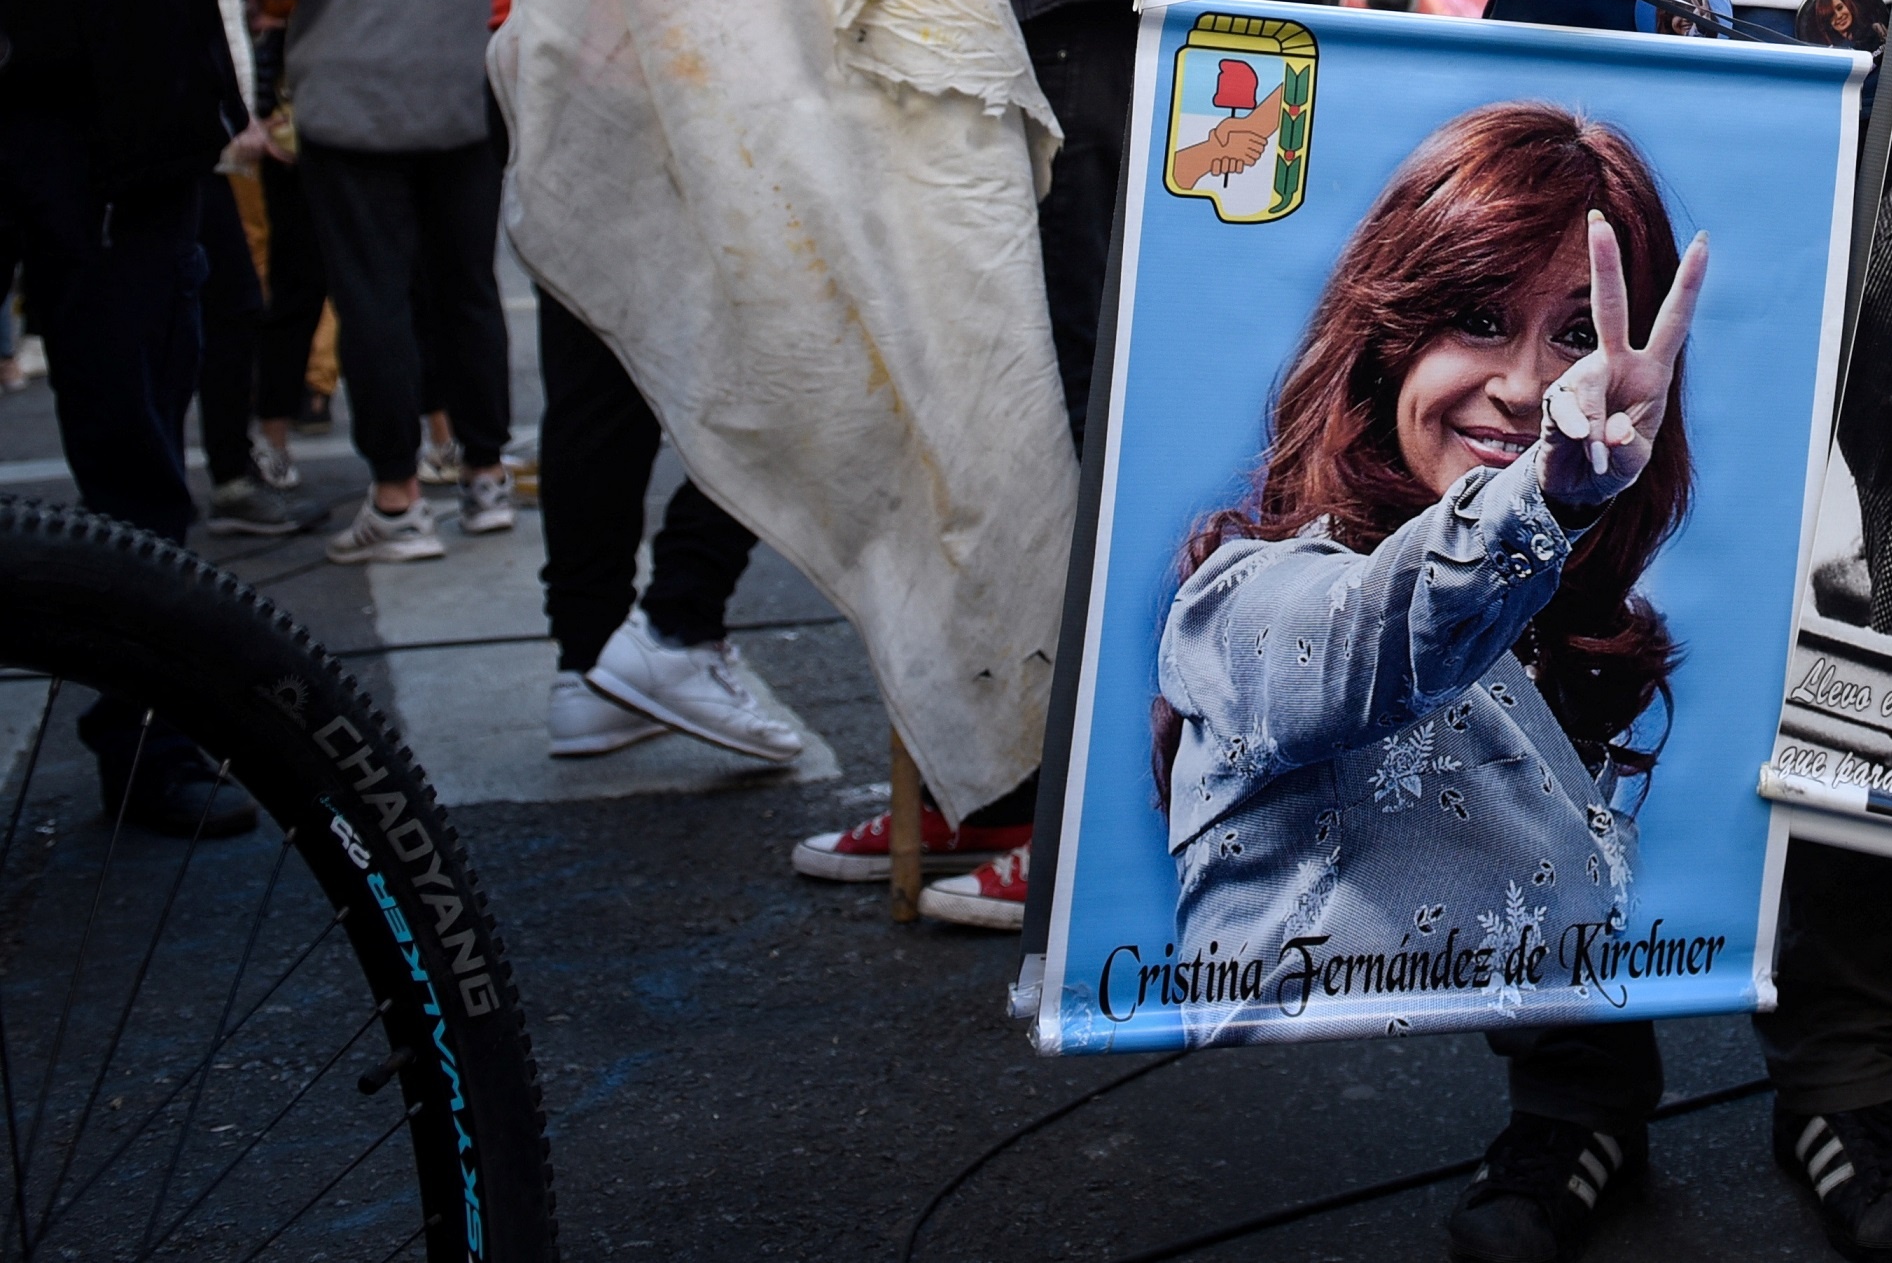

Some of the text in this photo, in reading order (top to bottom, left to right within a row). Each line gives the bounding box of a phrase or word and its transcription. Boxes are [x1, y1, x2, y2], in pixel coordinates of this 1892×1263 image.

[1790, 656, 1872, 712] Llevo
[312, 715, 500, 1019] CHAOYANG
[366, 871, 484, 1262] SKYWALKER
[1099, 918, 1726, 1023] Cristina Fernández de Kirchner
